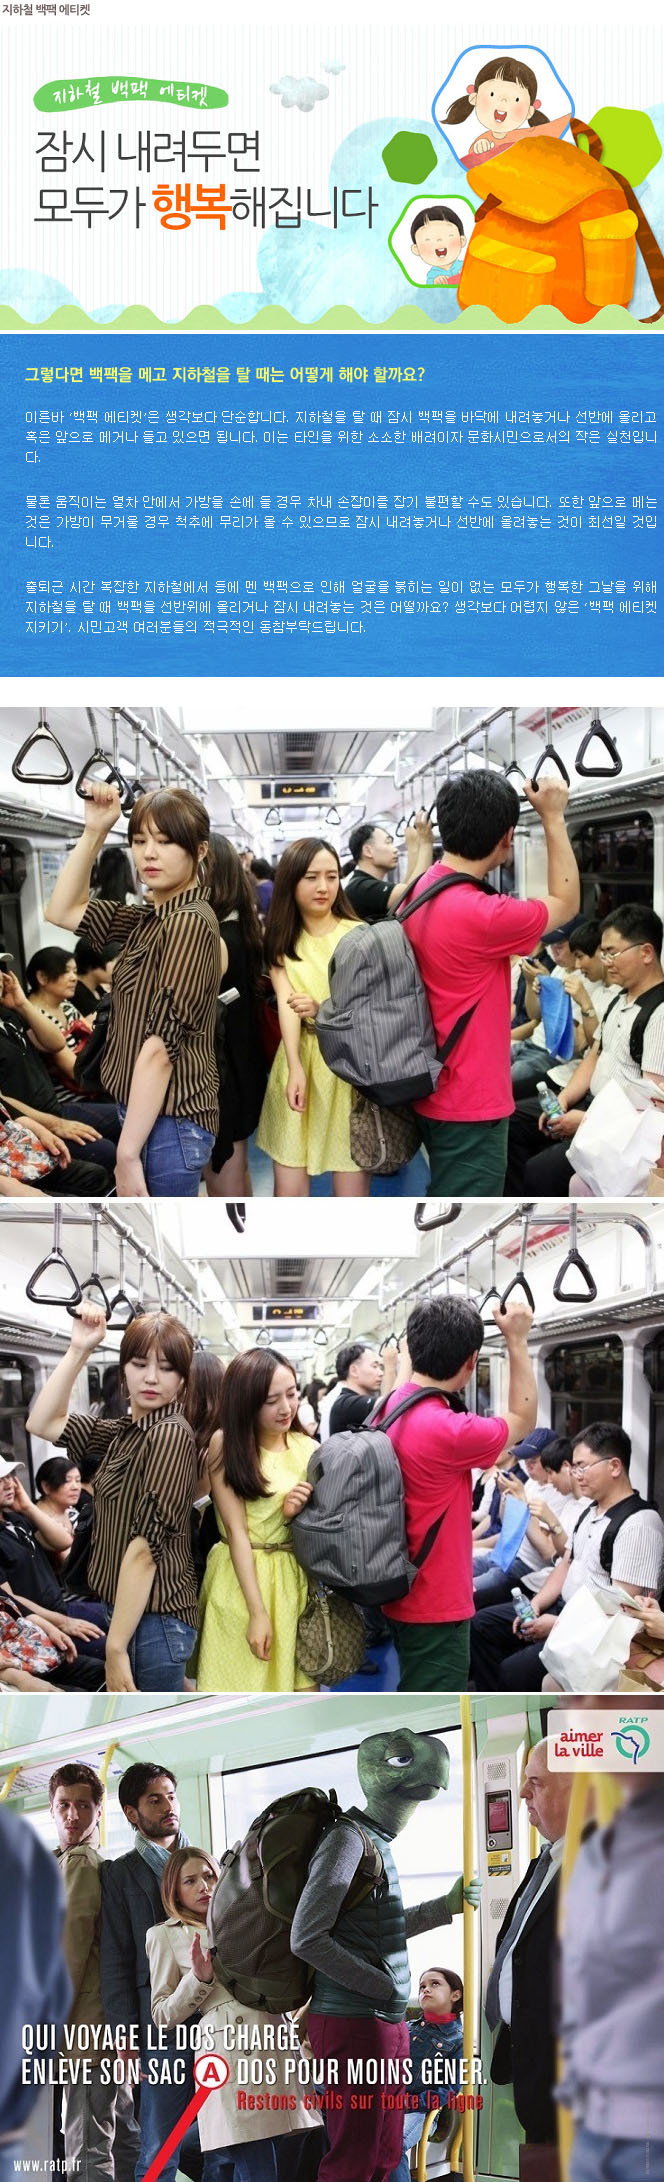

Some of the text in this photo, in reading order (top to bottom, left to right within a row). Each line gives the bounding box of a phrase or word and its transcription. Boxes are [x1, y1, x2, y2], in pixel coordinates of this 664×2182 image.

[53, 79, 208, 107] 지하철 백팩 에티켓
[35, 130, 261, 173] 잠시 내려두면
[34, 183, 379, 231] 모두가 행복해집니다
[25, 367, 425, 383] 그렇다면 백팩을 메고 지하철을 탈 때는 어떻게 해야 할까요?
[26, 411, 64, 423] 이른바
[166, 411, 217, 423] 생각보다
[222, 411, 288, 423] 단순합니다.
[296, 411, 346, 423] 지하철을
[353, 411, 365, 423] 탈
[371, 411, 381, 423] 때
[388, 411, 411, 423] 잠시
[419, 411, 456, 423] 백팩을
[462, 411, 498, 423] 바닥에
[506, 411, 570, 423] 내려놓거나
[576, 411, 612, 423] 선반에
[619, 411, 656, 423] 올리고
[26, 431, 656, 443] 혹은 앞으로 메거나 들고 있으면 됩니다. 이는 타인을 위한 소소한 배려이자 문화시민으로서의 작은 실천입니
[26, 451, 40, 463] 다.
[26, 496, 657, 508] 물론 움직이는 열차 안에서 가방을 손에 들 경우 차내 손잡이를 잡기 불편할 수도 있습니다. 또한 앞으로 메는
[26, 516, 656, 528] 것은 가방이 무거울 경우 척추에 무리가 올 수 있으므로 잠시 내려놓거나 선반에 올려놓는 것이 최선일 것입
[26, 536, 53, 548] 니다.
[26, 581, 656, 593] 출퇴근 시간 복잡한 지하철에서 등에 멘 백팩으로 인해 얼굴을 붉히는 일이 없는 모두가 행복한 그날을 위해
[26, 601, 76, 613] 지하철을
[83, 601, 95, 613] 탈
[100, 601, 110, 613] 때
[118, 601, 155, 613] 백팩을
[161, 601, 210, 613] 선반위에
[217, 601, 268, 613] 올리거나
[274, 601, 297, 613] 잠시
[304, 601, 354, 613] 내려놓는
[361, 601, 385, 613] 것은
[391, 601, 448, 613] 어떨까요?
[455, 601, 506, 613] 생각보다
[511, 601, 547, 613] 어렵지
[555, 601, 579, 613] 않은
[620, 601, 656, 613] 에티켓
[26, 621, 365, 633] 지키기’. 시민고객 여러분들의 적극적인 동참부탁드립니다.
[560, 1728, 604, 1742] aimer
[554, 1743, 604, 1757] la ville
[21, 2024, 56, 2054] QUI
[63, 2024, 139, 2051] VOYAGE
[147, 2024, 168, 2051] LE
[176, 2024, 215, 2051] DOS
[21, 2052, 92, 2085] ENLÈVE
[100, 2058, 140, 2085] SON
[148, 2058, 186, 2085] SAC
[238, 2058, 277, 2085] DOS
[285, 2058, 339, 2085] POUR
[347, 2058, 413, 2085] MOINS
[421, 2052, 488, 2085] GÊNER.
[237, 2090, 484, 2113] Restons civils sur toute la ligne
[13, 2158, 82, 2174] www.ratp.fr
